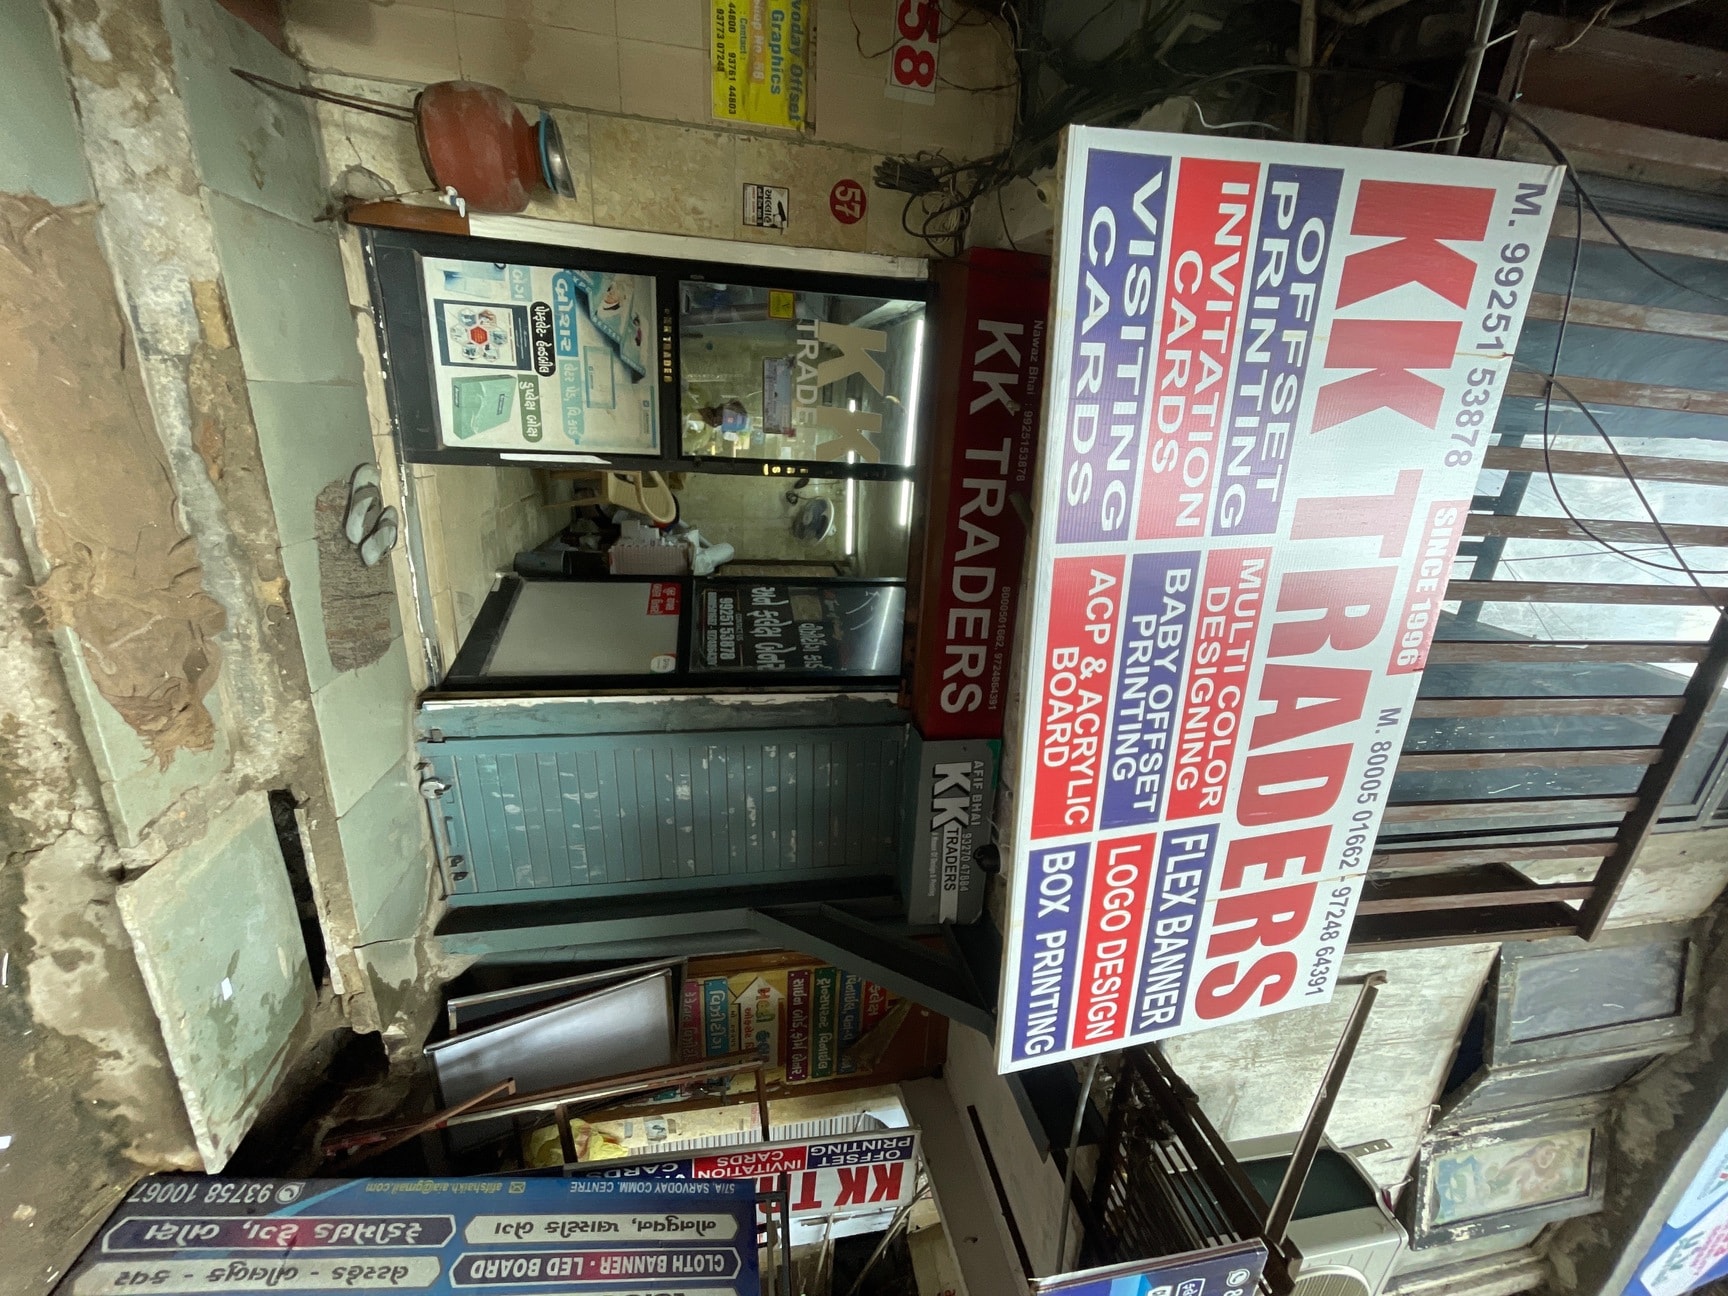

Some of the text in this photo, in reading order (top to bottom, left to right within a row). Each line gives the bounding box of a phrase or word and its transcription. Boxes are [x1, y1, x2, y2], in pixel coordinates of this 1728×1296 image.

[740, 18, 748, 54] Contact
[768, 9, 785, 95] Graphics
[894, 0, 941, 88] 58
[788, 64, 804, 122] Offset
[835, 186, 862, 219] 57
[1028, 320, 1044, 362] Nawaz
[1066, 206, 1116, 507] CARDS
[1100, 170, 1163, 532] VISITING
[1176, 181, 1249, 527] INVITATION
[1220, 181, 1300, 529] PRINTING
[1444, 182, 1548, 467] M. 99251 53878
[1025, 366, 1040, 395] Bhai
[1151, 249, 1203, 475] CARDS
[1256, 217, 1325, 502] OFFSET
[1015, 410, 1034, 482] 9925153878
[940, 319, 1024, 714] KK TRADERS
[1194, 179, 1497, 1020] KK TRADERS
[1397, 508, 1458, 666] SINCE 1996
[719, 597, 736, 660] 99251 53878
[1043, 646, 1080, 768] BOARD
[1064, 569, 1115, 826] ACP & ACRYLIC
[1112, 615, 1156, 781] PRINTING
[1133, 568, 1192, 813] BABY OFFSET
[1176, 586, 1230, 791] DESIGNING
[1198, 559, 1264, 810] MULTI COLOR
[1374, 707, 1402, 734] M.
[970, 760, 985, 826] AFIF BHAI
[1357, 741, 1392, 804] 80005
[931, 761, 972, 891] KK TRADERS
[1339, 810, 1374, 870] 01662
[1084, 845, 1142, 1041] LOGO DESIGN
[1139, 834, 1208, 1029] FLEX BANNER
[1319, 887, 1351, 943] 97248
[1023, 850, 1076, 1055] BOX PRINTING
[1305, 946, 1335, 996] 64391
[585, 1162, 679, 1179] CARDS
[697, 1159, 802, 1179] INVITATION
[716, 1150, 785, 1167] CARDS
[810, 1137, 911, 1156] PRINTING
[816, 1149, 901, 1167] OFFSET
[130, 1181, 275, 1204] 93758 10067
[570, 1180, 614, 1193] CENTRE
[618, 1180, 652, 1193] COMM.
[653, 1181, 710, 1194] SARVODAY
[835, 1162, 905, 1208] KK
[494, 1221, 534, 1240] બેગ
[113, 1269, 172, 1287] કવર
[470, 1253, 725, 1279] CLOTH BANNER LED BOARD
